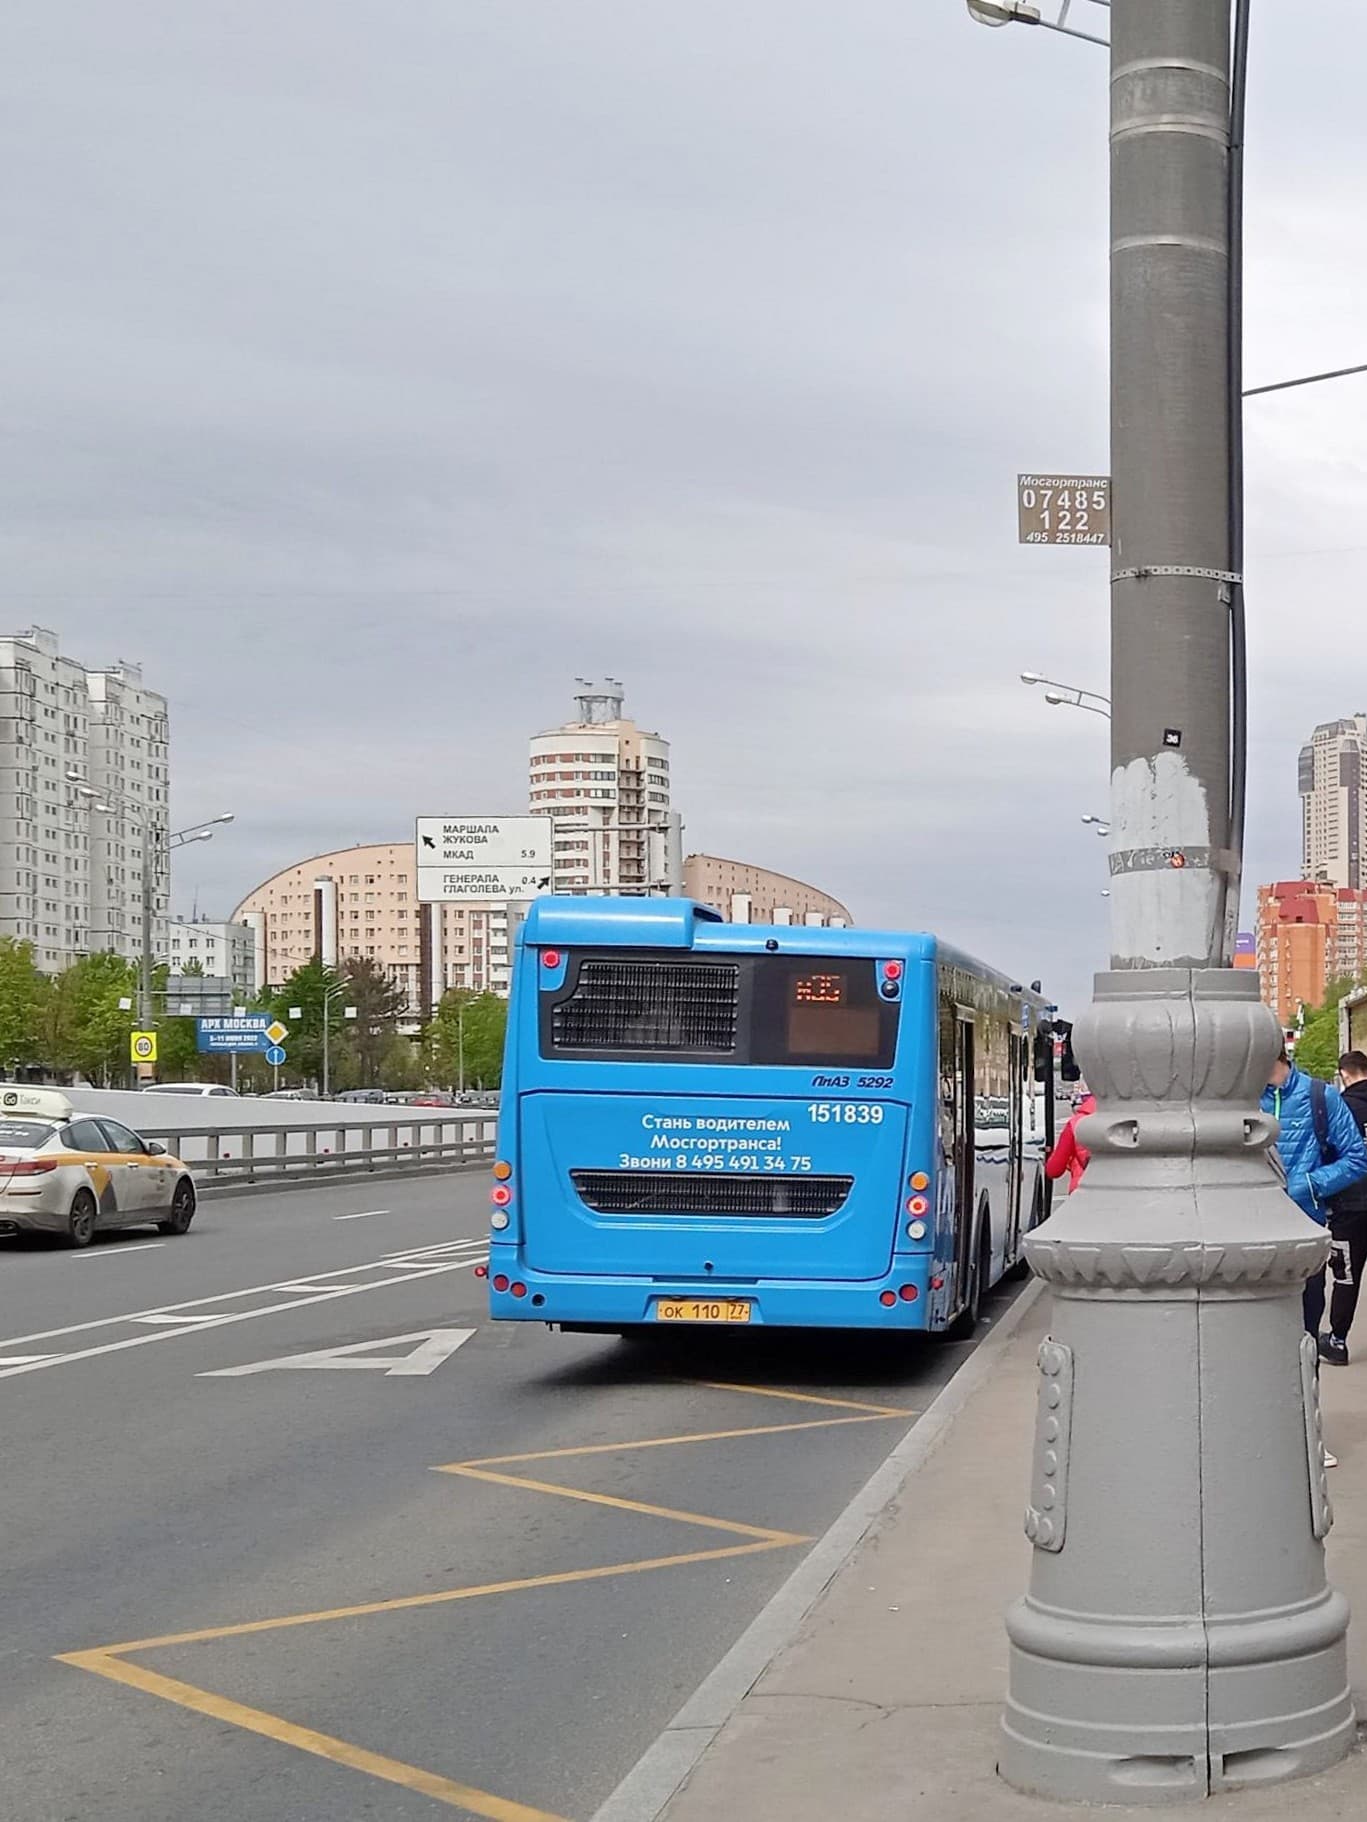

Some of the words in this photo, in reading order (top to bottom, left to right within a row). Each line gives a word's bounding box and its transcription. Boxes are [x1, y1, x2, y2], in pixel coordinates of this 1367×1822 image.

[1020, 475, 1108, 489] Мосгортранс
[1022, 489, 1106, 510] 07485
[1040, 510, 1089, 530] 122
[1026, 532, 1048, 543] 495
[1056, 533, 1105, 544] 2518447
[443, 824, 500, 834] МАРШАЛА
[443, 835, 488, 844] ЖУКОВА
[443, 850, 474, 860] МКАД
[521, 850, 536, 858] 5.9
[443, 874, 500, 884] ГЕНЕРАЛА
[521, 876, 537, 885] 0.4
[443, 884, 507, 893] ГЛАГОЛЕВА
[201, 1018, 221, 1029] АРХ
[223, 1018, 266, 1029] МОСКВА
[856, 1077, 894, 1089] 5292
[808, 1103, 884, 1124] 151839
[642, 1115, 692, 1130] Стань
[696, 1117, 791, 1131] водителем
[650, 1134, 782, 1152] Мосгортранса!
[619, 1154, 671, 1169] Звони
[676, 1154, 688, 1168] 8
[691, 1155, 724, 1169] 495
[728, 1155, 758, 1169] 491
[763, 1156, 785, 1170] 34
[790, 1156, 812, 1171] 75
[692, 1304, 720, 1319] 110
[730, 1303, 745, 1316] 77
